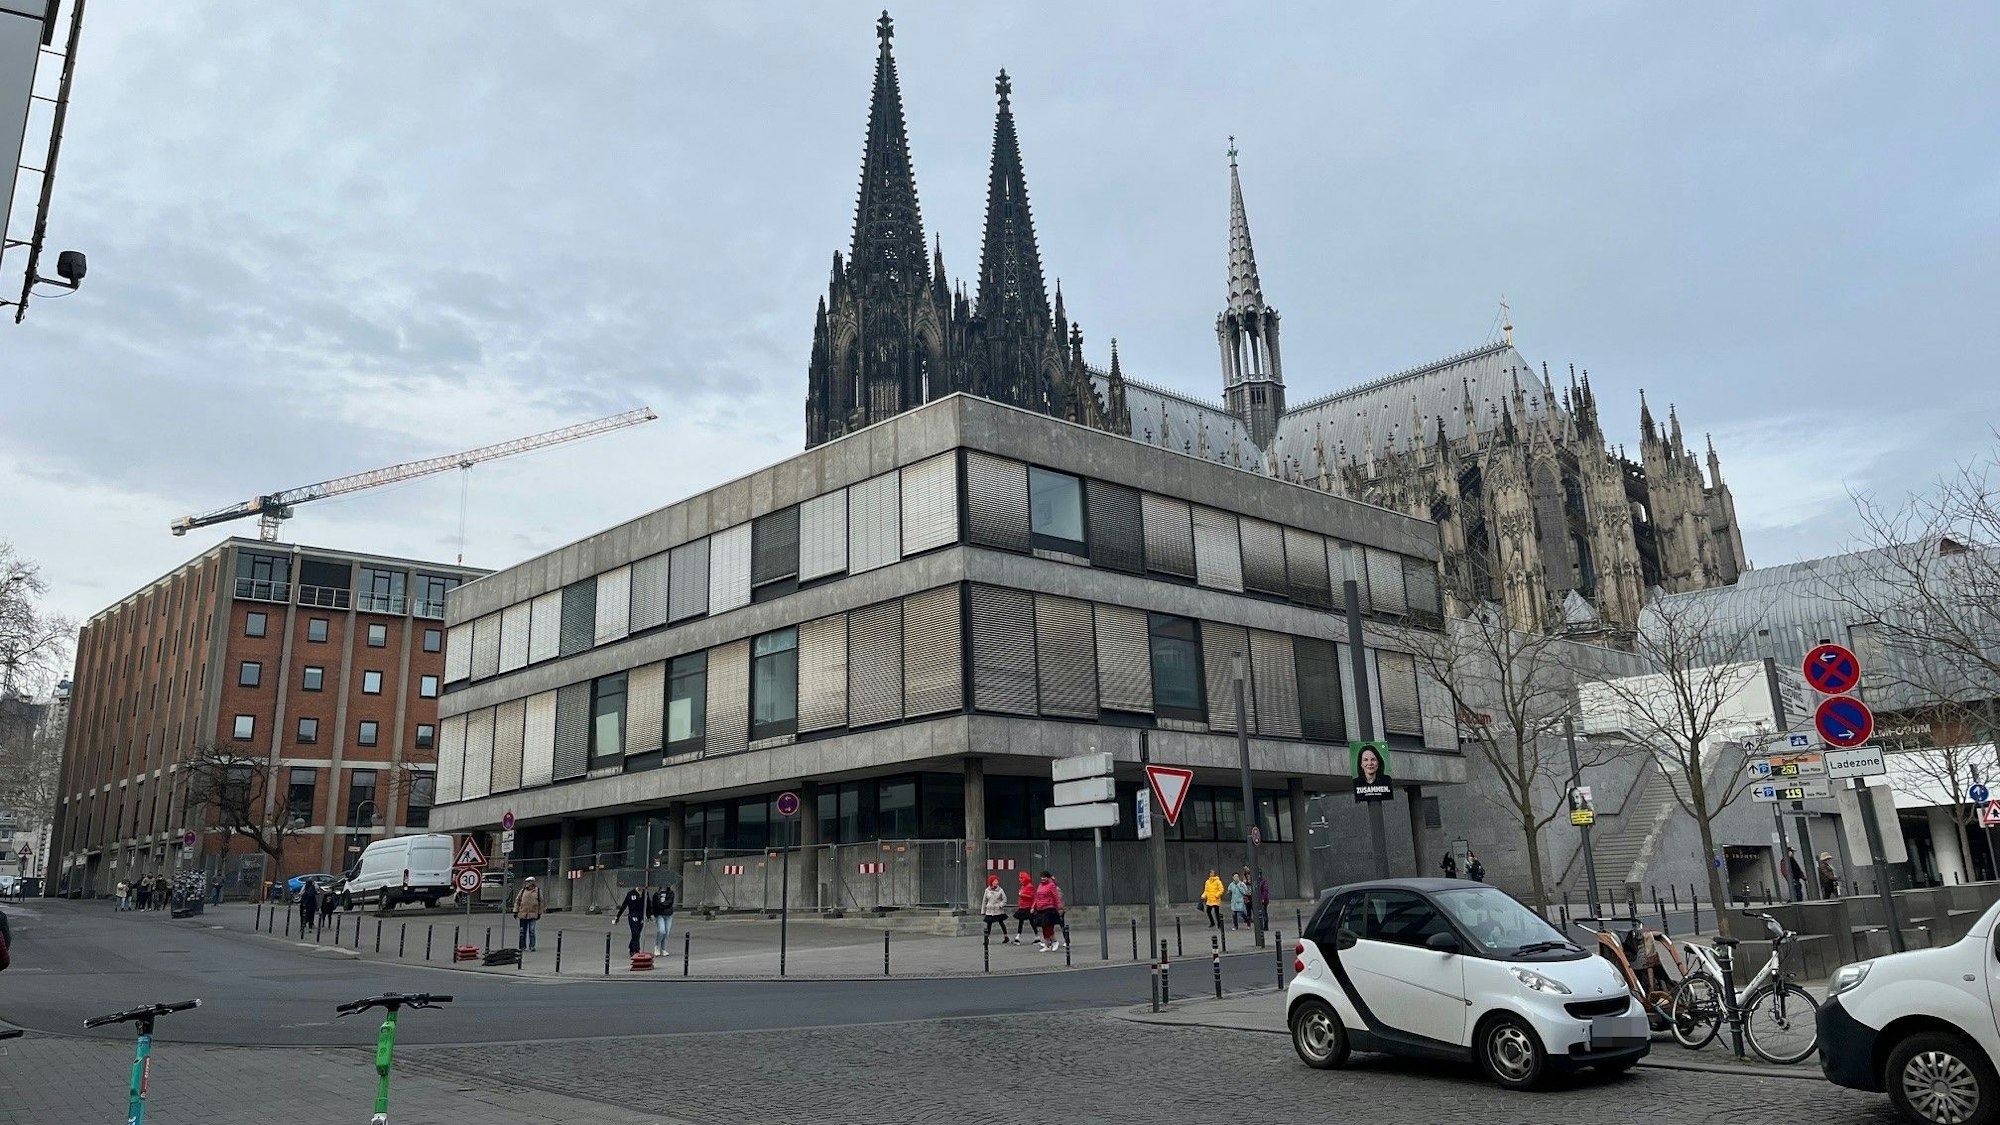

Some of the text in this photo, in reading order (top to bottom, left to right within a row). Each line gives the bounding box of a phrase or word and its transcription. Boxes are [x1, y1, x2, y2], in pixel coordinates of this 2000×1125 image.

[1831, 758, 1879, 769] Ladezone
[1356, 785, 1391, 794] ZUSAMMEN.
[1784, 788, 1802, 799] 119
[462, 874, 476, 887] 30
